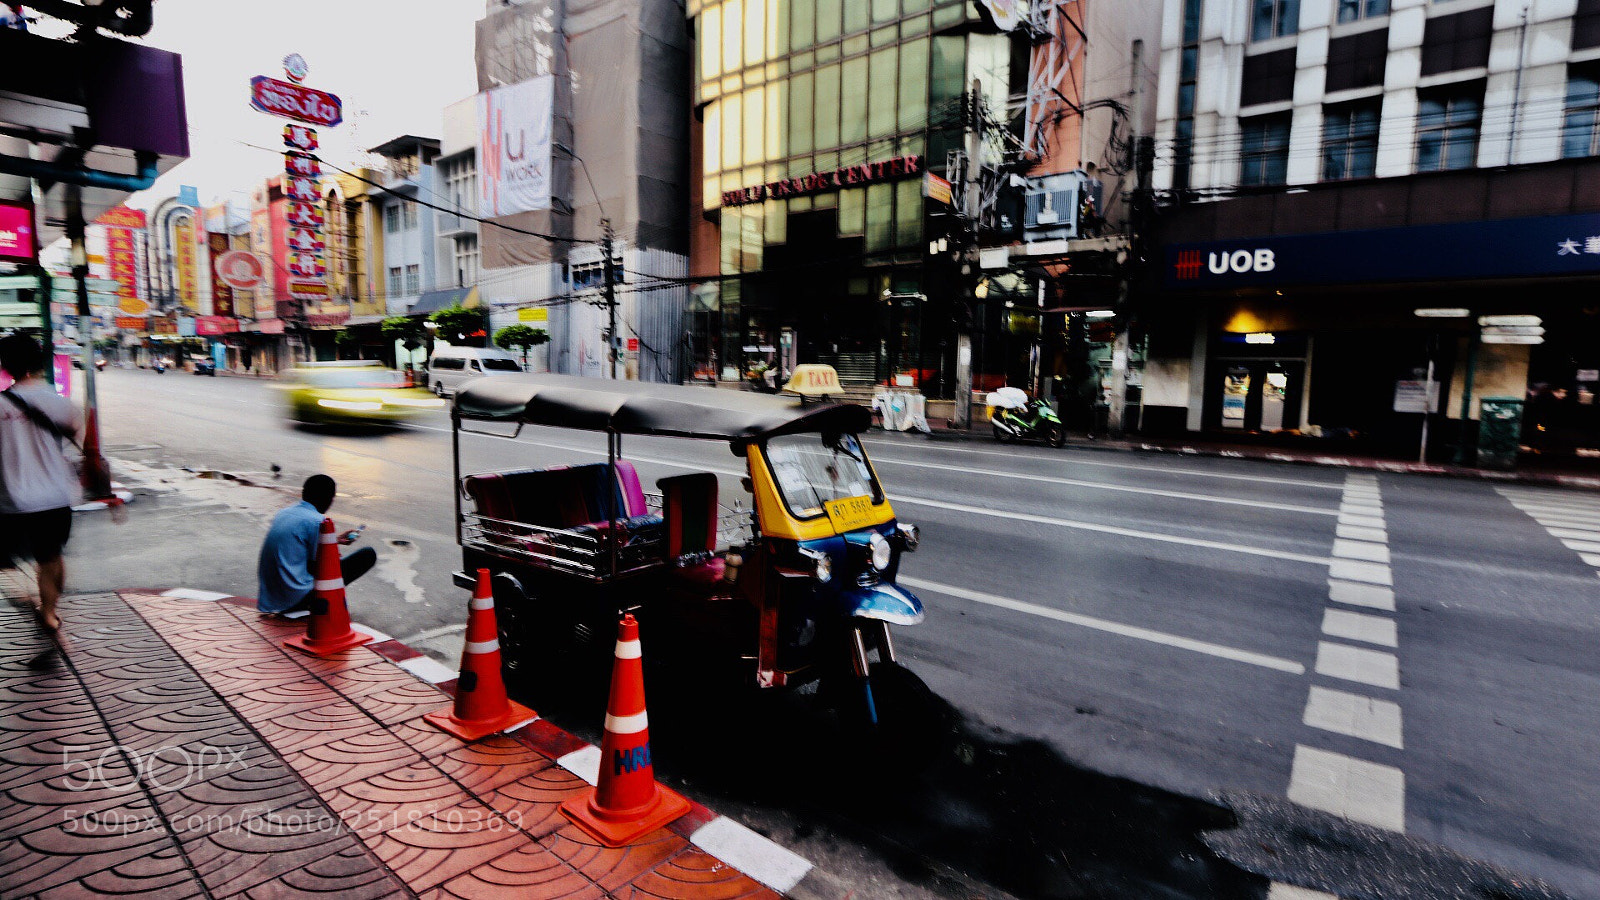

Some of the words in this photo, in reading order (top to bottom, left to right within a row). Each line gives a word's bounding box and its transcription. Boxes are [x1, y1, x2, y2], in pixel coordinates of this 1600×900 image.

[765, 173, 829, 198] TRADE
[833, 155, 919, 187] CENTER
[1208, 248, 1276, 274] UOB
[808, 370, 834, 387] TAXI
